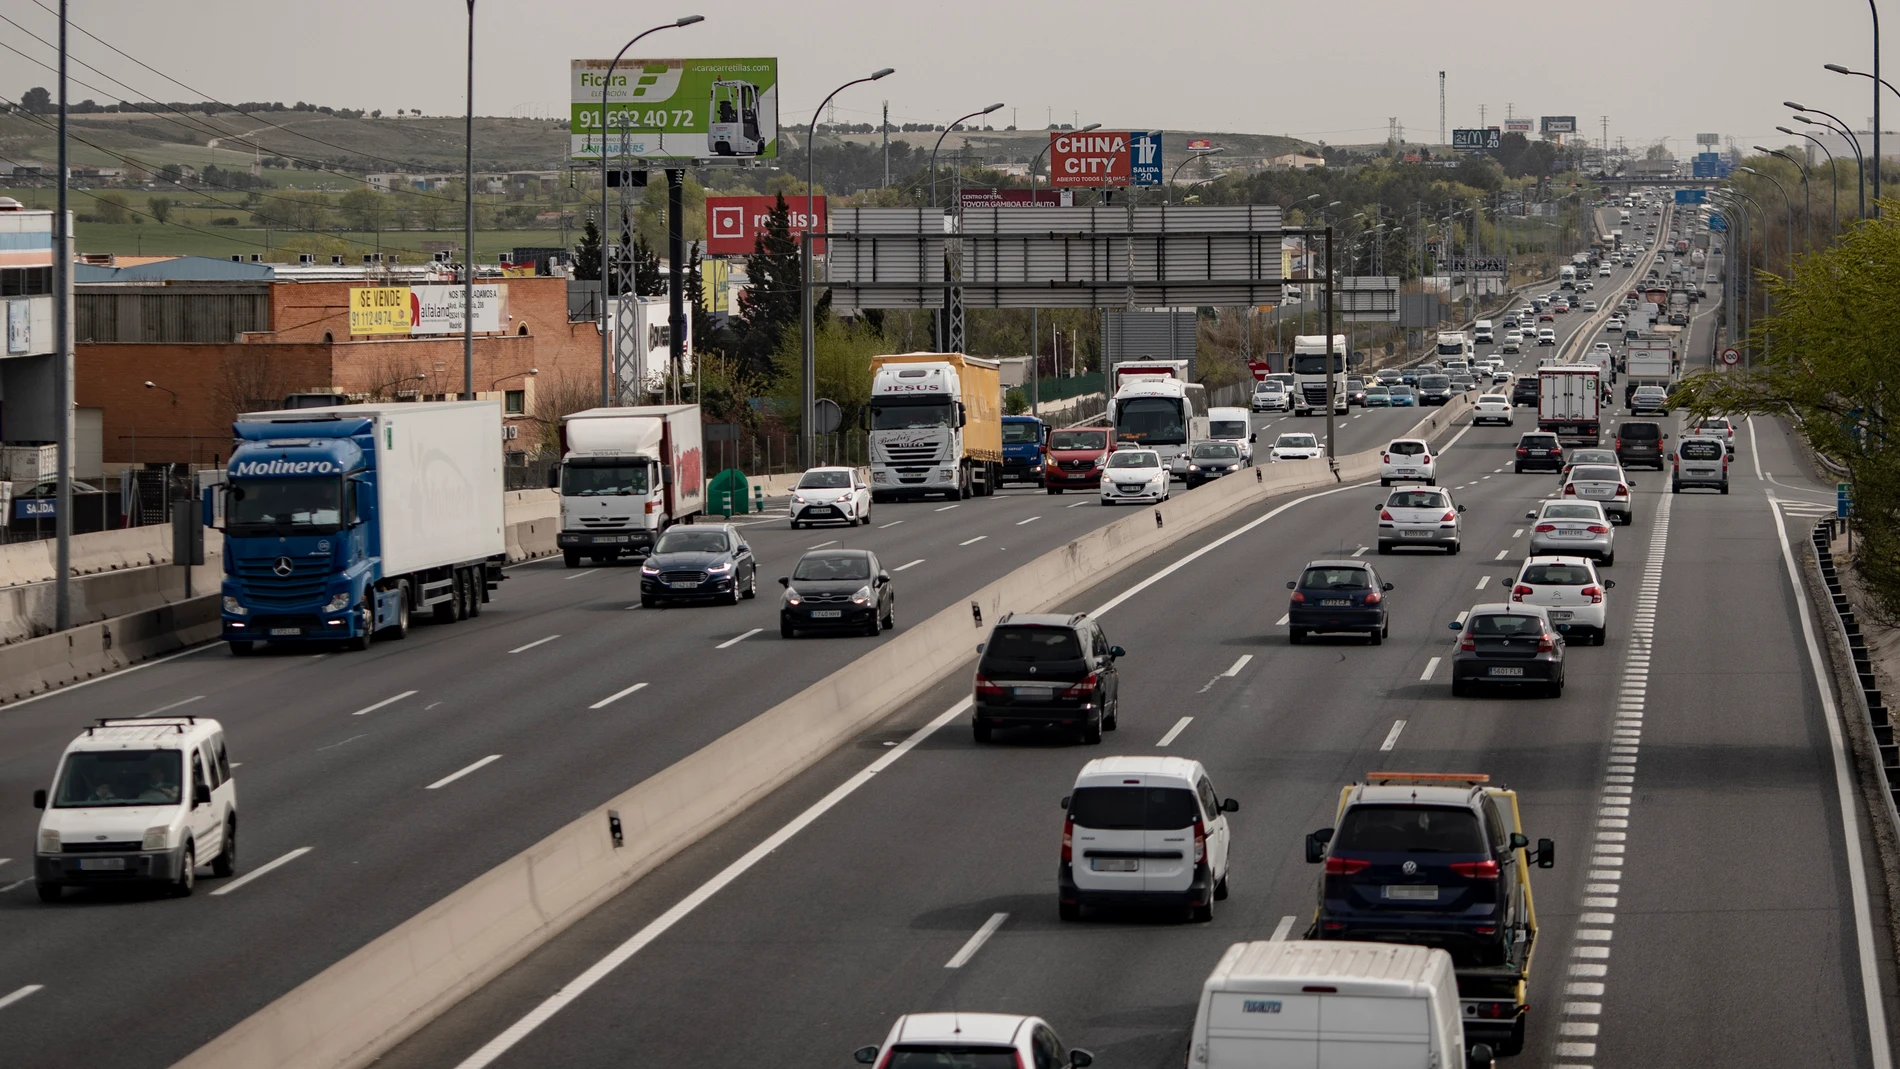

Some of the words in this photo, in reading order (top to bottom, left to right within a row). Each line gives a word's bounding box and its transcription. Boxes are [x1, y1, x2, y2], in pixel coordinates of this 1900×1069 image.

[581, 73, 627, 87] Ficara
[591, 88, 627, 97] ELEACIÓN
[579, 110, 602, 128] 91
[643, 110, 667, 128] 40
[671, 109, 694, 127] 72
[1055, 136, 1127, 153] CHINA
[1486, 139, 1499, 148] 20
[1064, 157, 1117, 174] CITY
[1140, 173, 1152, 181] 20
[360, 290, 371, 307] SE
[373, 289, 401, 307] VENDE
[448, 290, 459, 299] NOS
[420, 302, 450, 318] alfaland
[352, 311, 360, 326] 91
[361, 311, 373, 326] 112
[383, 310, 392, 325] 74
[883, 384, 939, 392] JESUS
[1587, 380, 1595, 389] 9
[236, 459, 332, 477] Molinero
[1489, 667, 1507, 676] 5601
[1508, 667, 1524, 676] FLR
